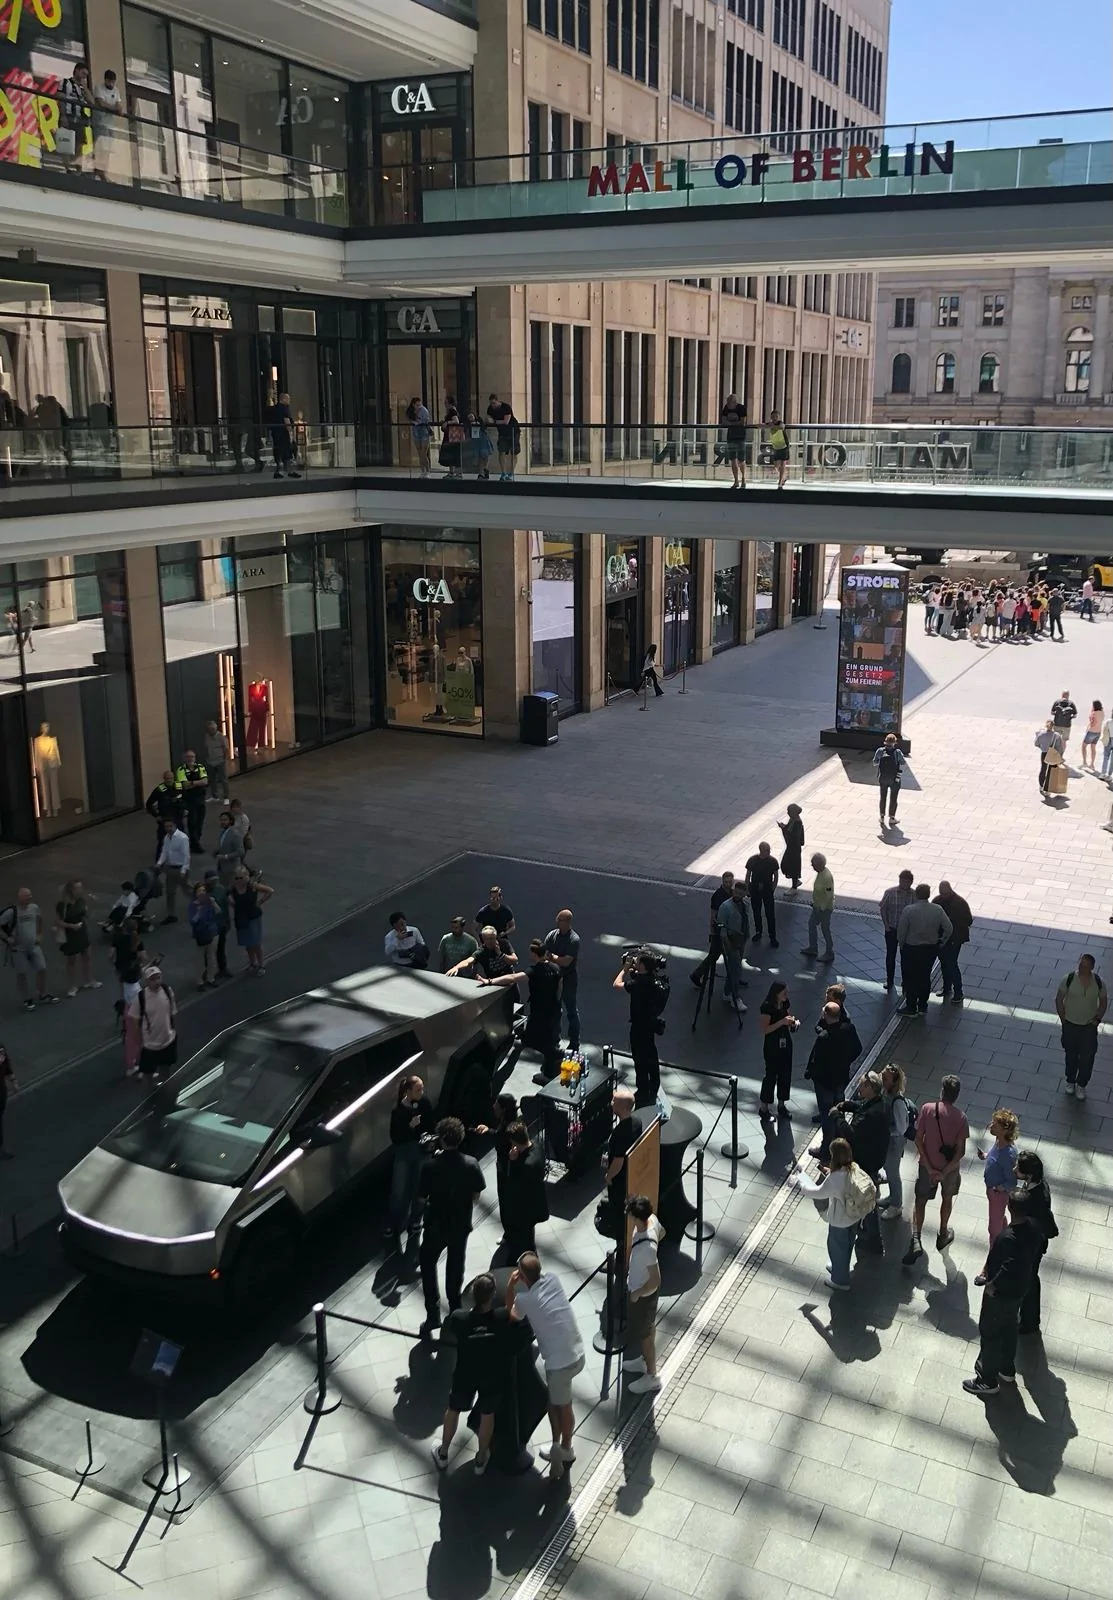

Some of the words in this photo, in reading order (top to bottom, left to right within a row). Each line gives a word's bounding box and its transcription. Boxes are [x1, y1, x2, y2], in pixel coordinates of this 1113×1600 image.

[391, 82, 436, 115] C&A
[587, 158, 695, 197] MALL
[715, 152, 770, 188] OF
[792, 140, 955, 184] BERLIN
[397, 305, 441, 333] C&A
[413, 577, 454, 604] C&A
[847, 574, 900, 589] STRÖER
[845, 670, 883, 679] GESETZ
[860, 664, 883, 672] GRUND
